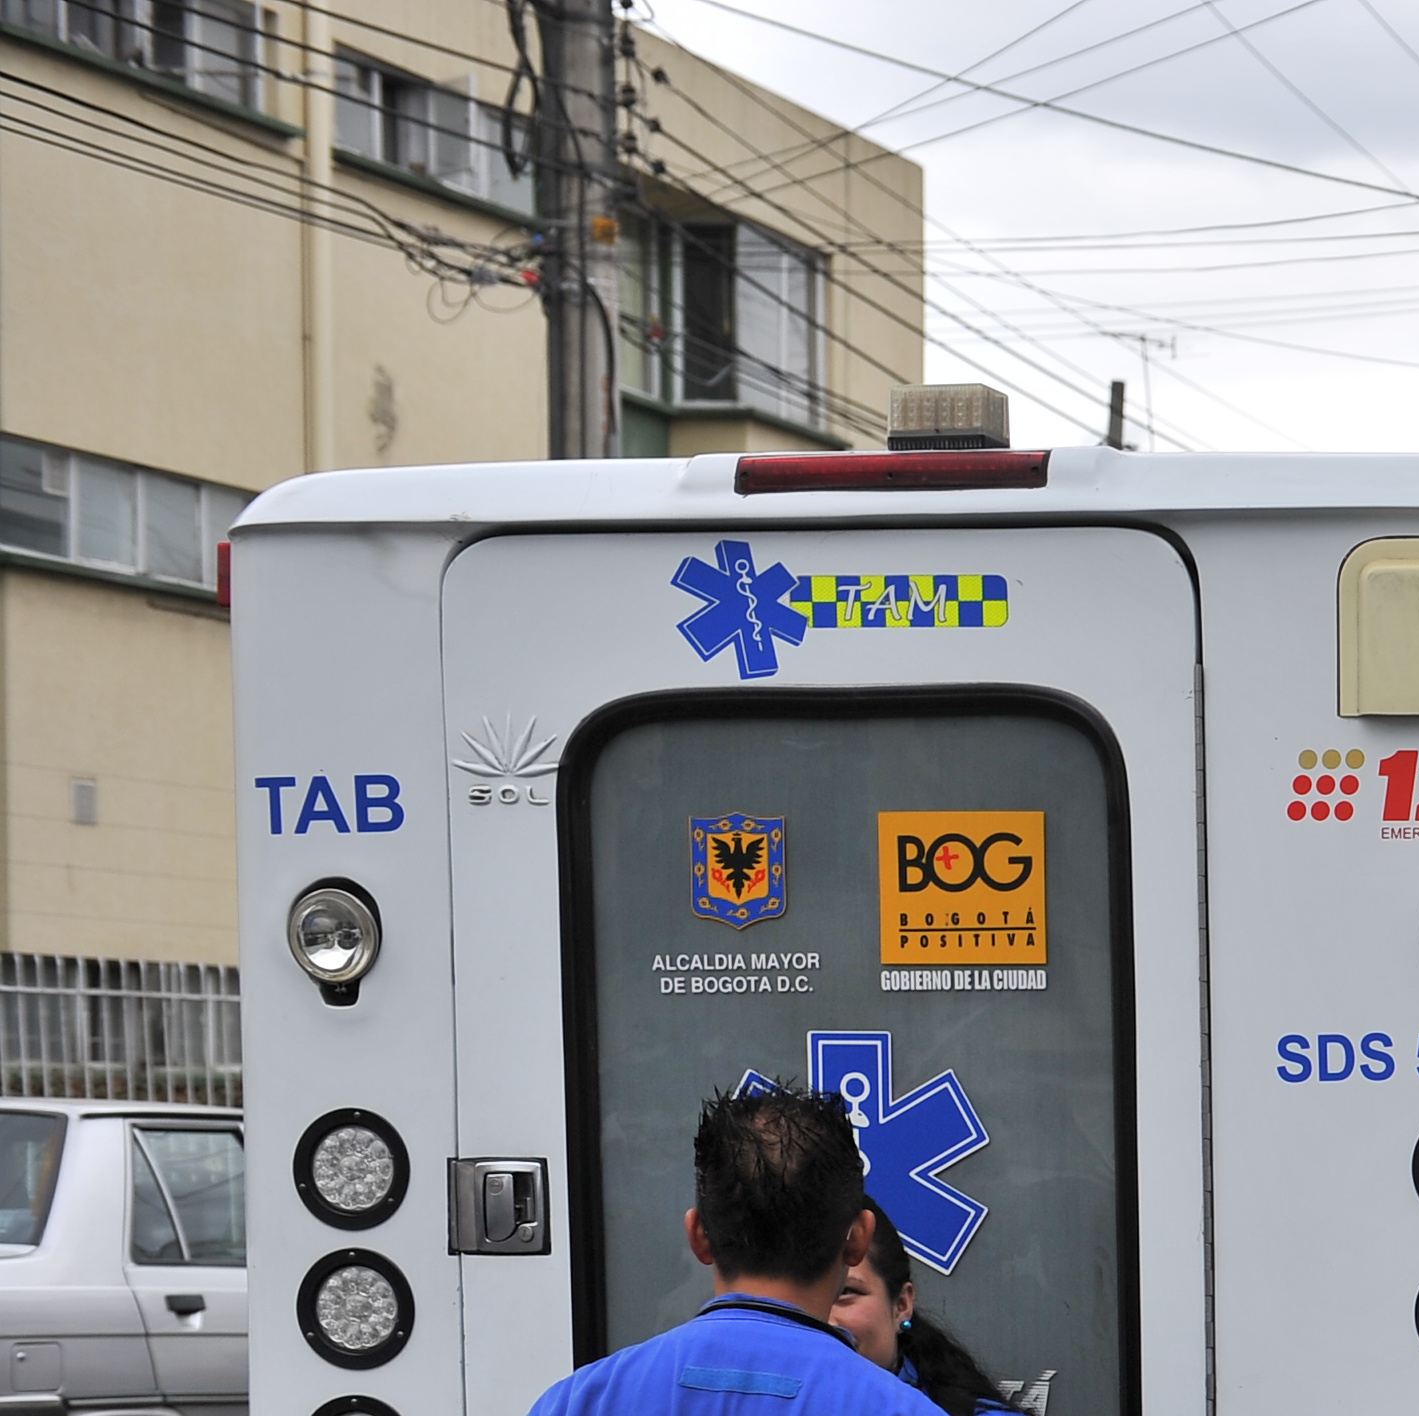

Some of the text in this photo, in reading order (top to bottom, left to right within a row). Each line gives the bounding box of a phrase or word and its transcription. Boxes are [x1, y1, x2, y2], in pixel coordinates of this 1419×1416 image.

[836, 582, 952, 625] TAM
[254, 773, 406, 836] TAB
[467, 782, 552, 808] SOL
[897, 832, 1033, 893] BOG
[900, 932, 1036, 949] POSITIVA
[651, 951, 821, 972] ALCALDIA MAYOR
[660, 974, 815, 995] DE BOGOTA D.C.
[880, 969, 1048, 991] GOBIERNO DE LA CIUDAD
[1275, 1032, 1396, 1084] SDS
